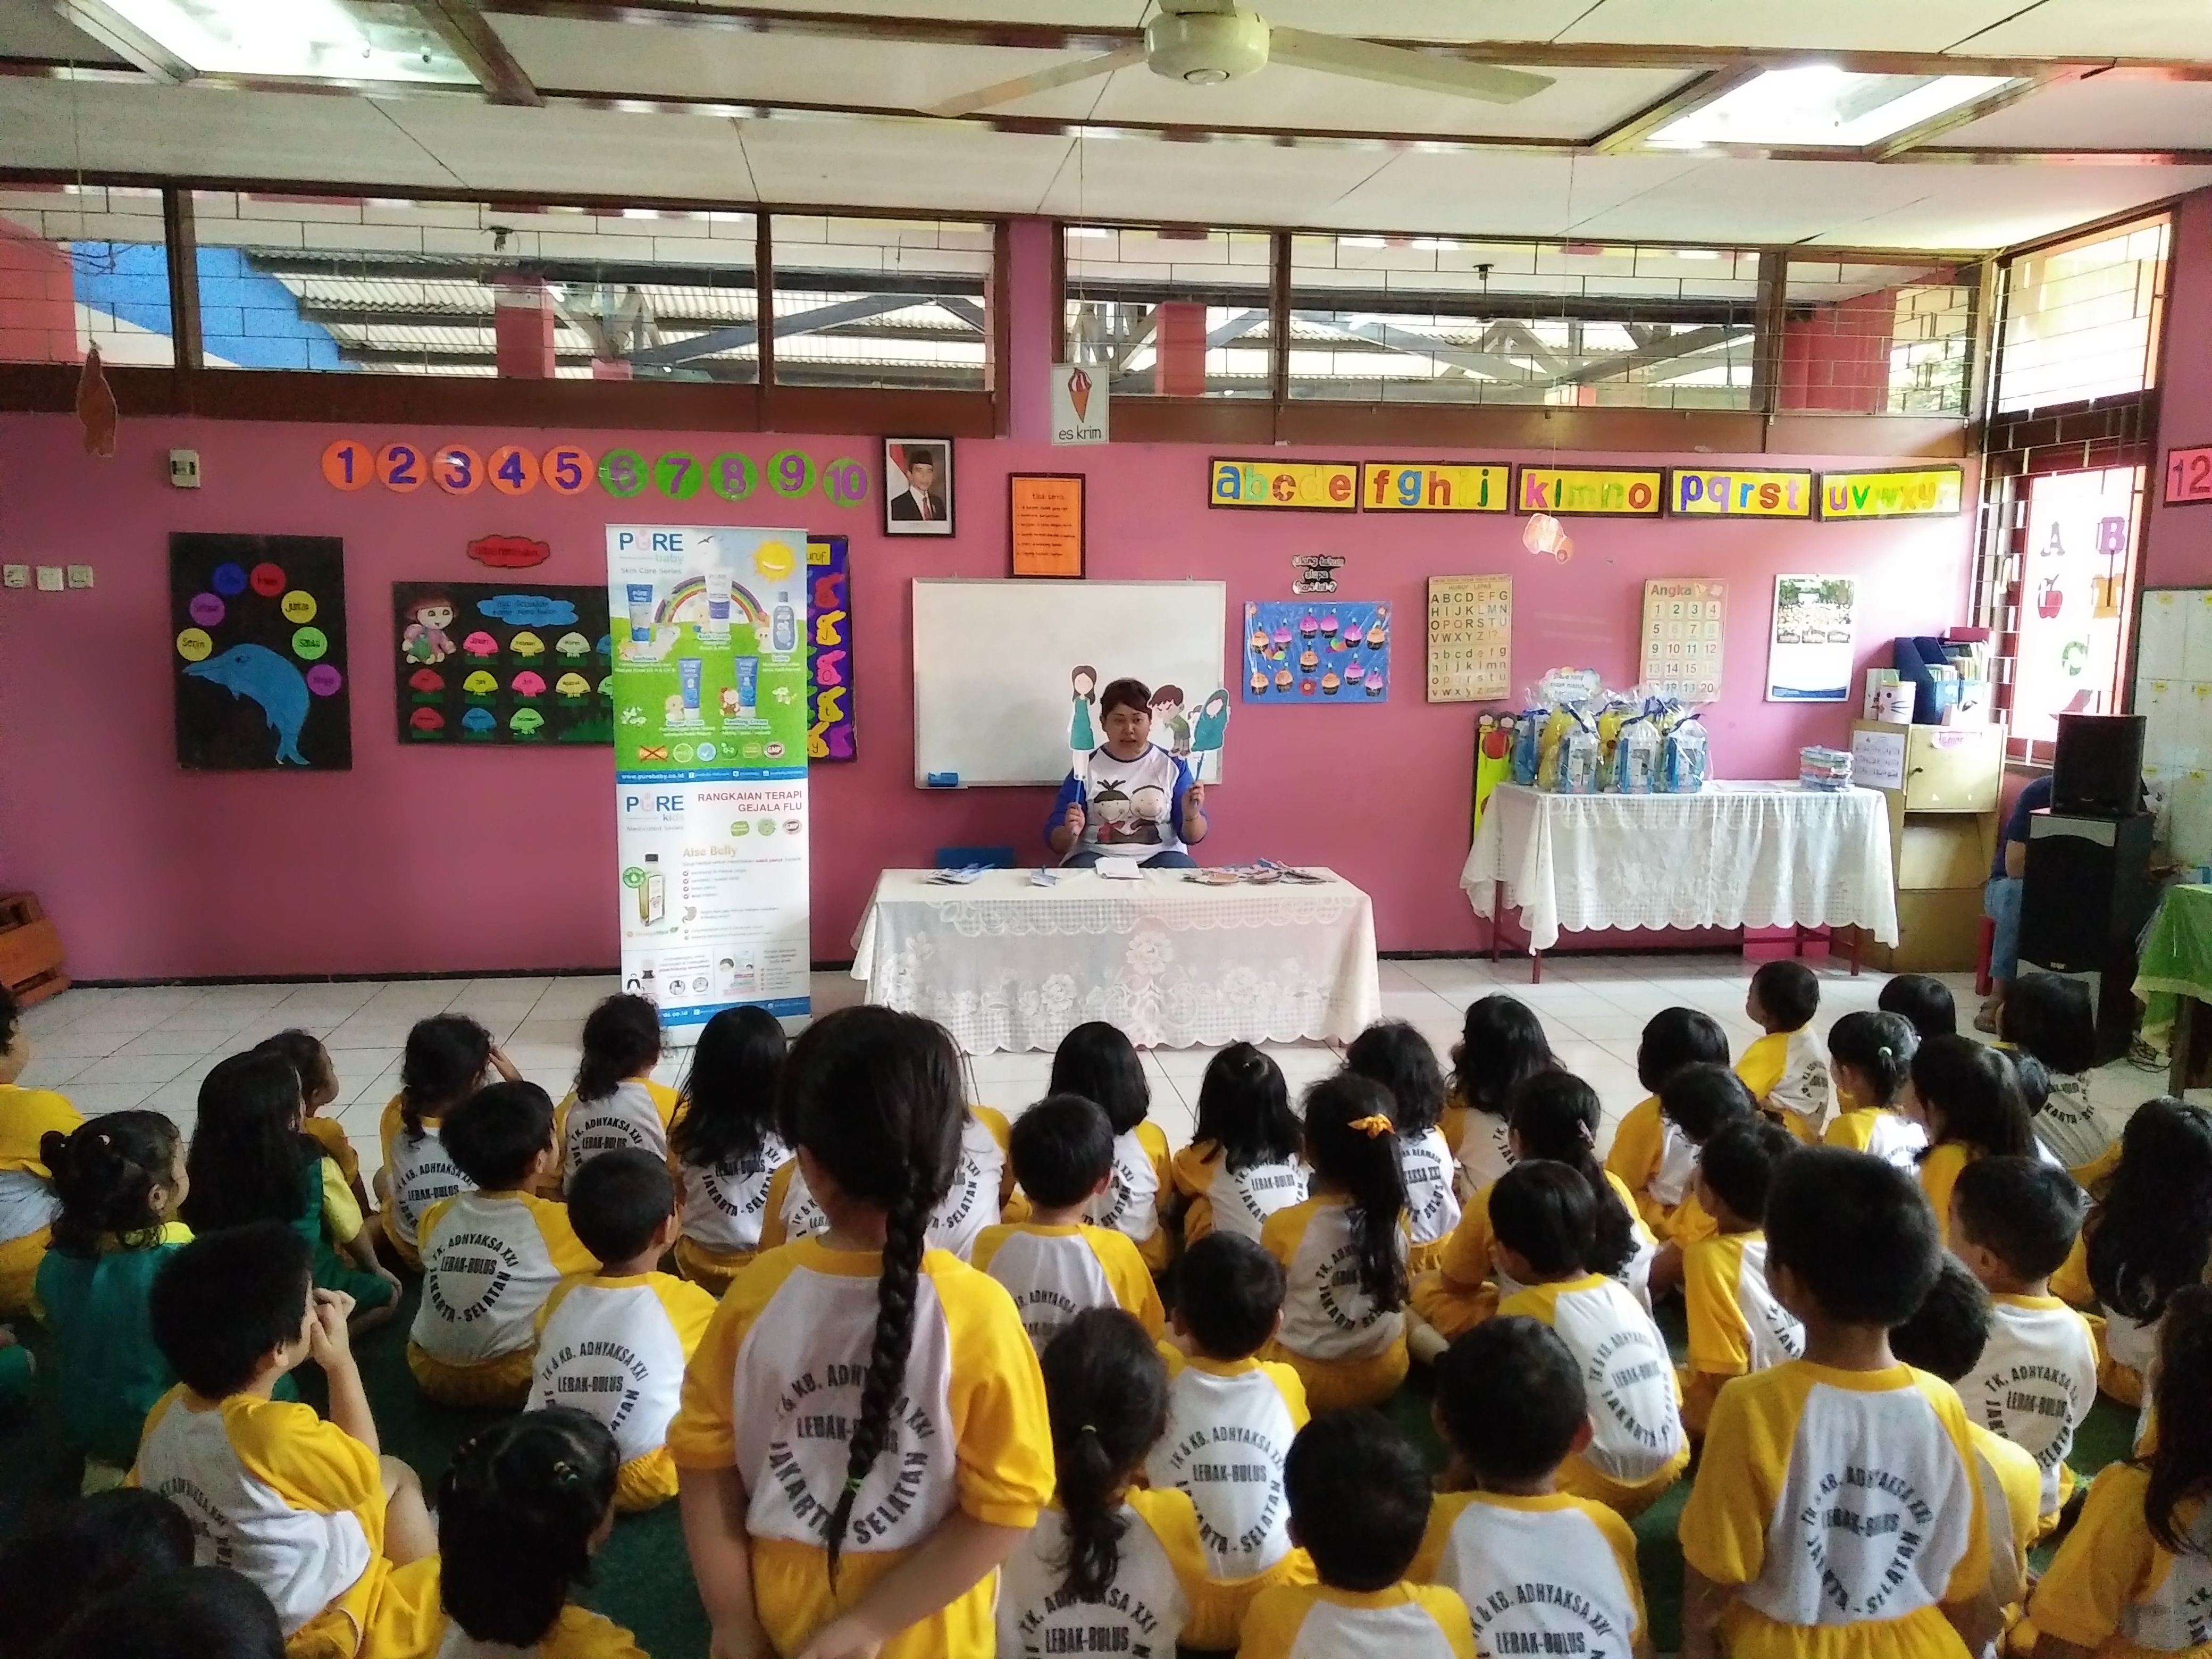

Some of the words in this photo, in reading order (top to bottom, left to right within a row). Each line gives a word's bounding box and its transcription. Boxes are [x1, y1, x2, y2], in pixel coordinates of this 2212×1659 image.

[1059, 428, 1074, 440] es
[1076, 425, 1101, 440] krim
[338, 447, 353, 483] 1
[389, 447, 416, 483] 2
[445, 451, 471, 488] 3
[498, 452, 525, 488] 4
[555, 453, 582, 489] 5
[611, 455, 636, 491] 6
[667, 458, 690, 493] 7
[723, 458, 745, 493] 8
[780, 455, 805, 491] 9
[828, 464, 867, 500] 10
[2173, 455, 2212, 496] 12
[619, 532, 684, 551] PURE
[2040, 521, 2065, 557] A
[2097, 516, 2125, 554] B
[656, 552, 684, 564] baby
[1293, 556, 1317, 566] Ulang
[1431, 594, 1439, 604] A
[1443, 593, 1451, 603] B
[1454, 593, 1462, 602] C
[1465, 592, 1473, 602] D
[1478, 592, 1485, 601] E
[1489, 591, 1495, 600] F
[1499, 591, 1508, 600] G
[1651, 584, 1691, 598] Angka
[1431, 607, 1439, 617] H
[1455, 606, 1461, 616] J
[1466, 606, 1473, 615] K
[1478, 605, 1484, 614] L
[1488, 605, 1496, 613] M
[1500, 604, 1507, 613] N
[1655, 604, 1660, 614] 1
[1673, 604, 1680, 614] 2
[1691, 604, 1698, 614] 3
[1710, 604, 1716, 614] 4
[1431, 620, 1440, 630] O
[1443, 620, 1450, 629] P
[1465, 618, 1473, 629] R
[1477, 618, 1484, 628] S
[1488, 618, 1495, 627] T
[1500, 617, 1506, 626] U
[1653, 624, 1660, 634] 5
[1690, 624, 1697, 634] 7
[1431, 633, 1439, 643] V
[1442, 633, 1452, 643] W
[1454, 633, 1462, 642] X
[1465, 632, 1472, 641] Y
[1477, 631, 1484, 641] Z
[1652, 643, 1658, 654] 9
[1668, 644, 1680, 654] 10
[1687, 644, 1697, 653] 11
[1705, 644, 1716, 653] 12
[1666, 663, 1679, 674] 14
[1686, 664, 1697, 673] 15
[1701, 683, 1714, 693] 20
[826, 707, 830, 716] t
[812, 743, 819, 753] y
[626, 795, 685, 812] PURE
[698, 792, 762, 802] RANGKAIAN
[765, 790, 802, 800] TERAPI
[738, 802, 781, 812] GEJALA
[783, 802, 802, 810] FLU
[663, 814, 684, 822] kids
[572, 1128, 584, 1142] TK.
[585, 1117, 631, 1131] ADHYAKSA
[629, 1128, 643, 1144] XXI
[765, 1146, 781, 1163] XXI
[419, 1162, 460, 1180] ADHYAKSA
[967, 1159, 981, 1177] XXI
[1120, 1164, 1135, 1182] XXI
[1251, 1174, 1295, 1192] LEBAK-BULUS
[408, 1184, 459, 1201] LEBAK-BULUS
[702, 1175, 738, 1217] JAKARTA
[946, 1180, 977, 1228] SELATAN
[448, 1233, 504, 1253] ADHYAKSA
[500, 1246, 520, 1268] XXI
[440, 1256, 498, 1275] LEBAK-BULUS
[463, 1271, 512, 1322] SELATAN
[559, 1346, 576, 1364] KB.
[579, 1341, 635, 1367] ADHYAKSA
[630, 1360, 649, 1382] XXI
[558, 1375, 624, 1393] LEBAK-BULUS
[791, 1373, 823, 1397] KB.
[906, 1407, 935, 1439] XXI
[1170, 1451, 1185, 1470] TK
[1189, 1430, 1210, 1449] KB.
[1212, 1426, 1271, 1454] ADHYAKSA
[1192, 1464, 1267, 1482] LEBAK-BULUS
[769, 1441, 830, 1536] JAKART
[852, 1452, 928, 1545] SELATAN
[1240, 1479, 1281, 1553] SELATAN
[1018, 1609, 1044, 1635] TK.
[1130, 1601, 1158, 1635] XXI
[1486, 1590, 1514, 1614] KB.
[1515, 1582, 1590, 1619] ADHYAKSA
[1588, 1611, 1613, 1637] XXI
[1045, 1626, 1129, 1654] LEBAK-BULUS
[1495, 1631, 1585, 1654] LEBAK-BULUS
